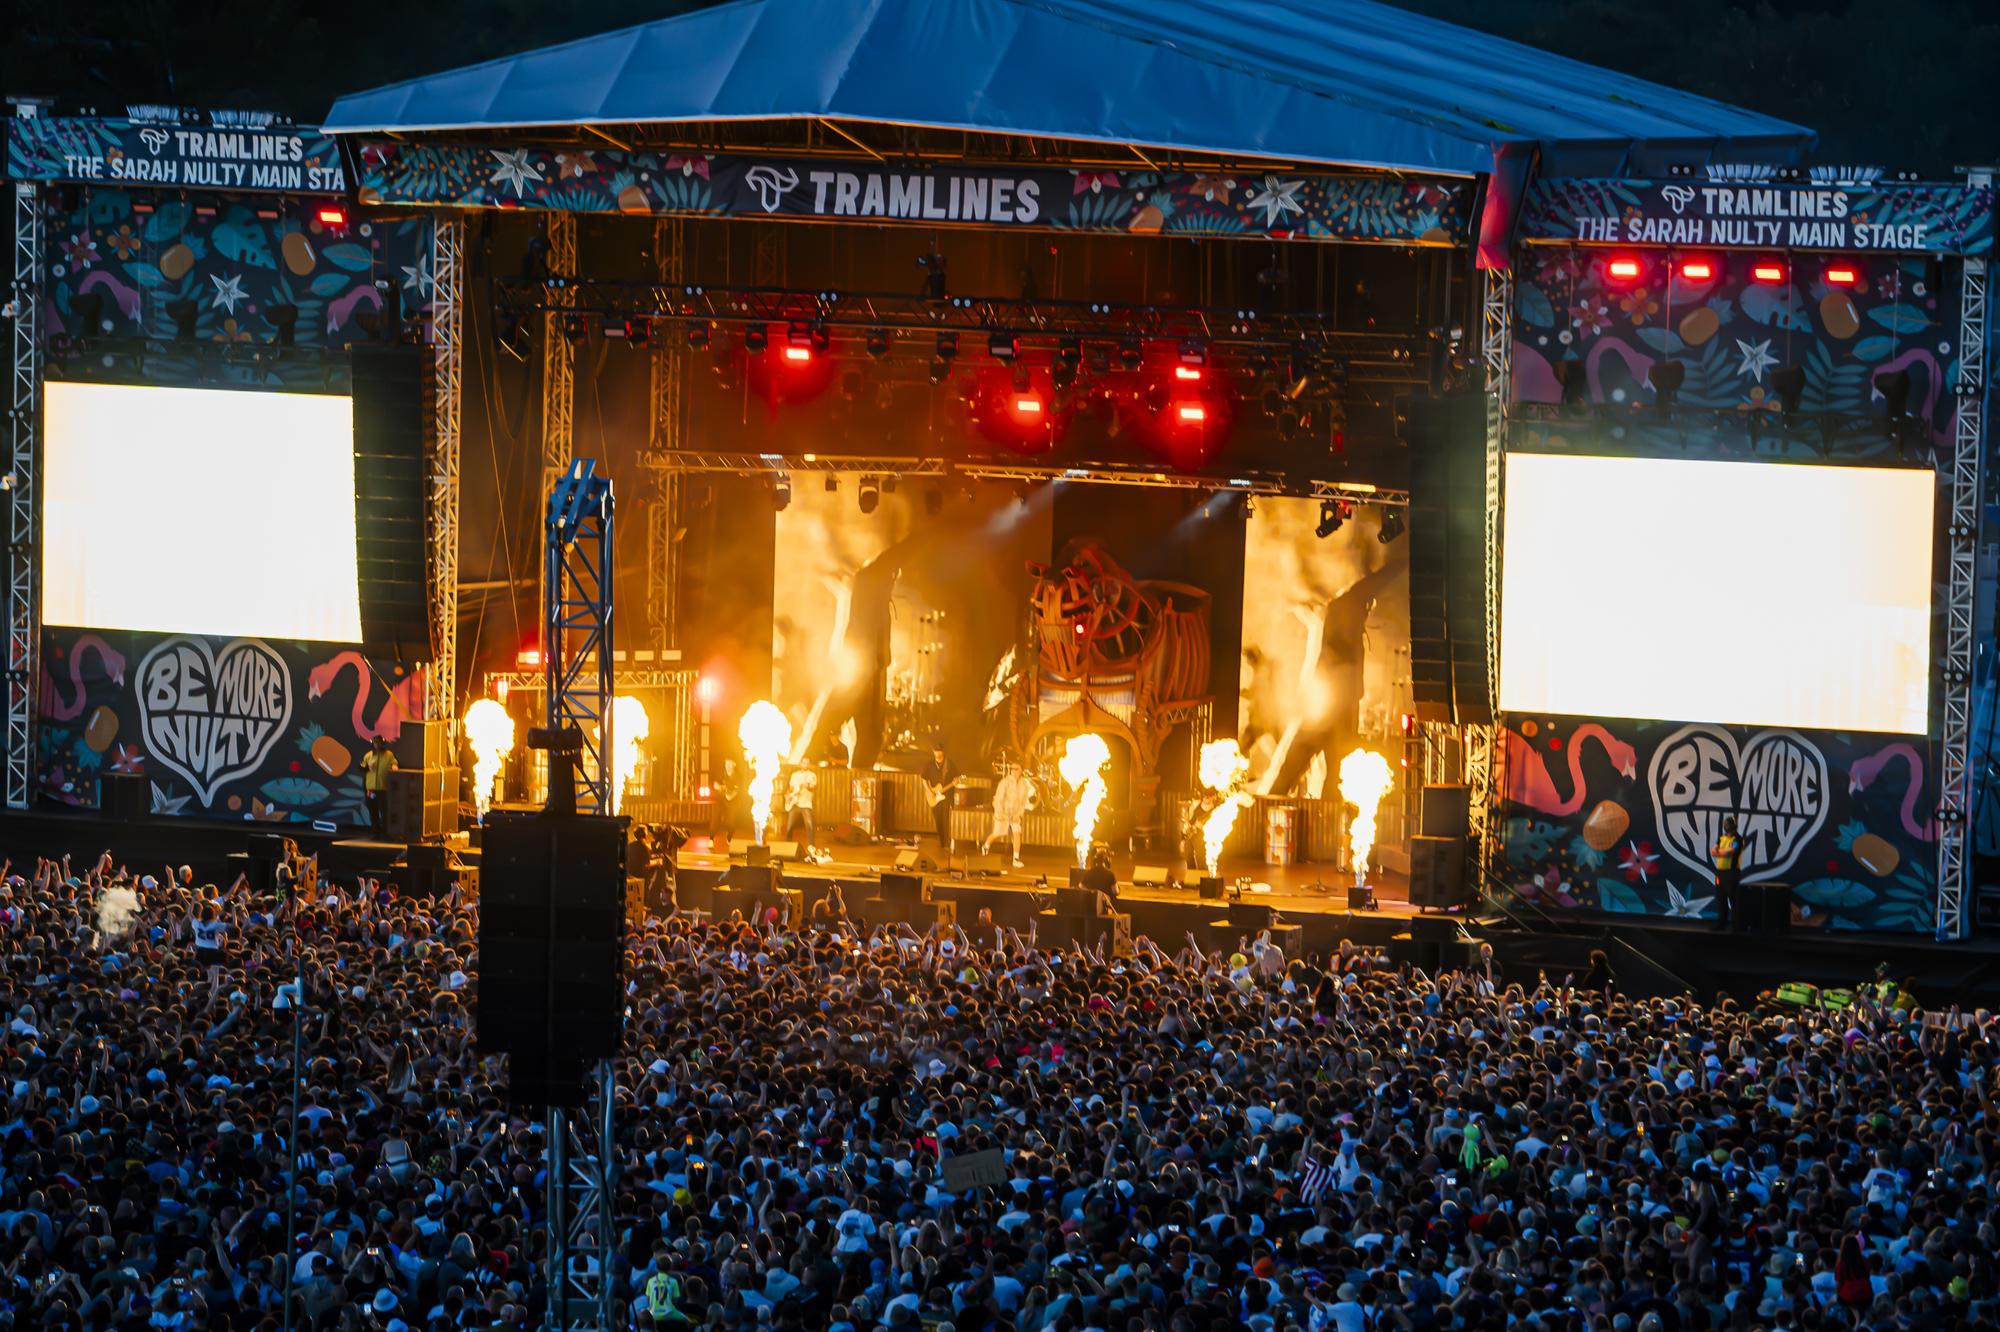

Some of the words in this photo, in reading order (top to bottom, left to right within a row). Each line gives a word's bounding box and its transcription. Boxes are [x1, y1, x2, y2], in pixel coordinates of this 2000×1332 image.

[174, 131, 303, 162] TRAMLINES
[65, 155, 104, 179] THE
[110, 157, 178, 184] SARAH
[183, 163, 246, 187] NULTY
[251, 165, 301, 190] MAIN
[809, 171, 1041, 224] TRAMLINES
[1701, 188, 1848, 218] TRAMLINES
[1575, 217, 1620, 241] THE
[1627, 219, 1703, 244] SARAH
[1710, 221, 1782, 245] NULTY
[1788, 223, 1846, 248] MAIN
[1853, 223, 1927, 249] STAGE
[147, 647, 209, 712] BE
[215, 648, 283, 719] MORE
[150, 714, 274, 783] NULTY
[1661, 736, 1734, 808] BE
[1739, 739, 1818, 815] MORE
